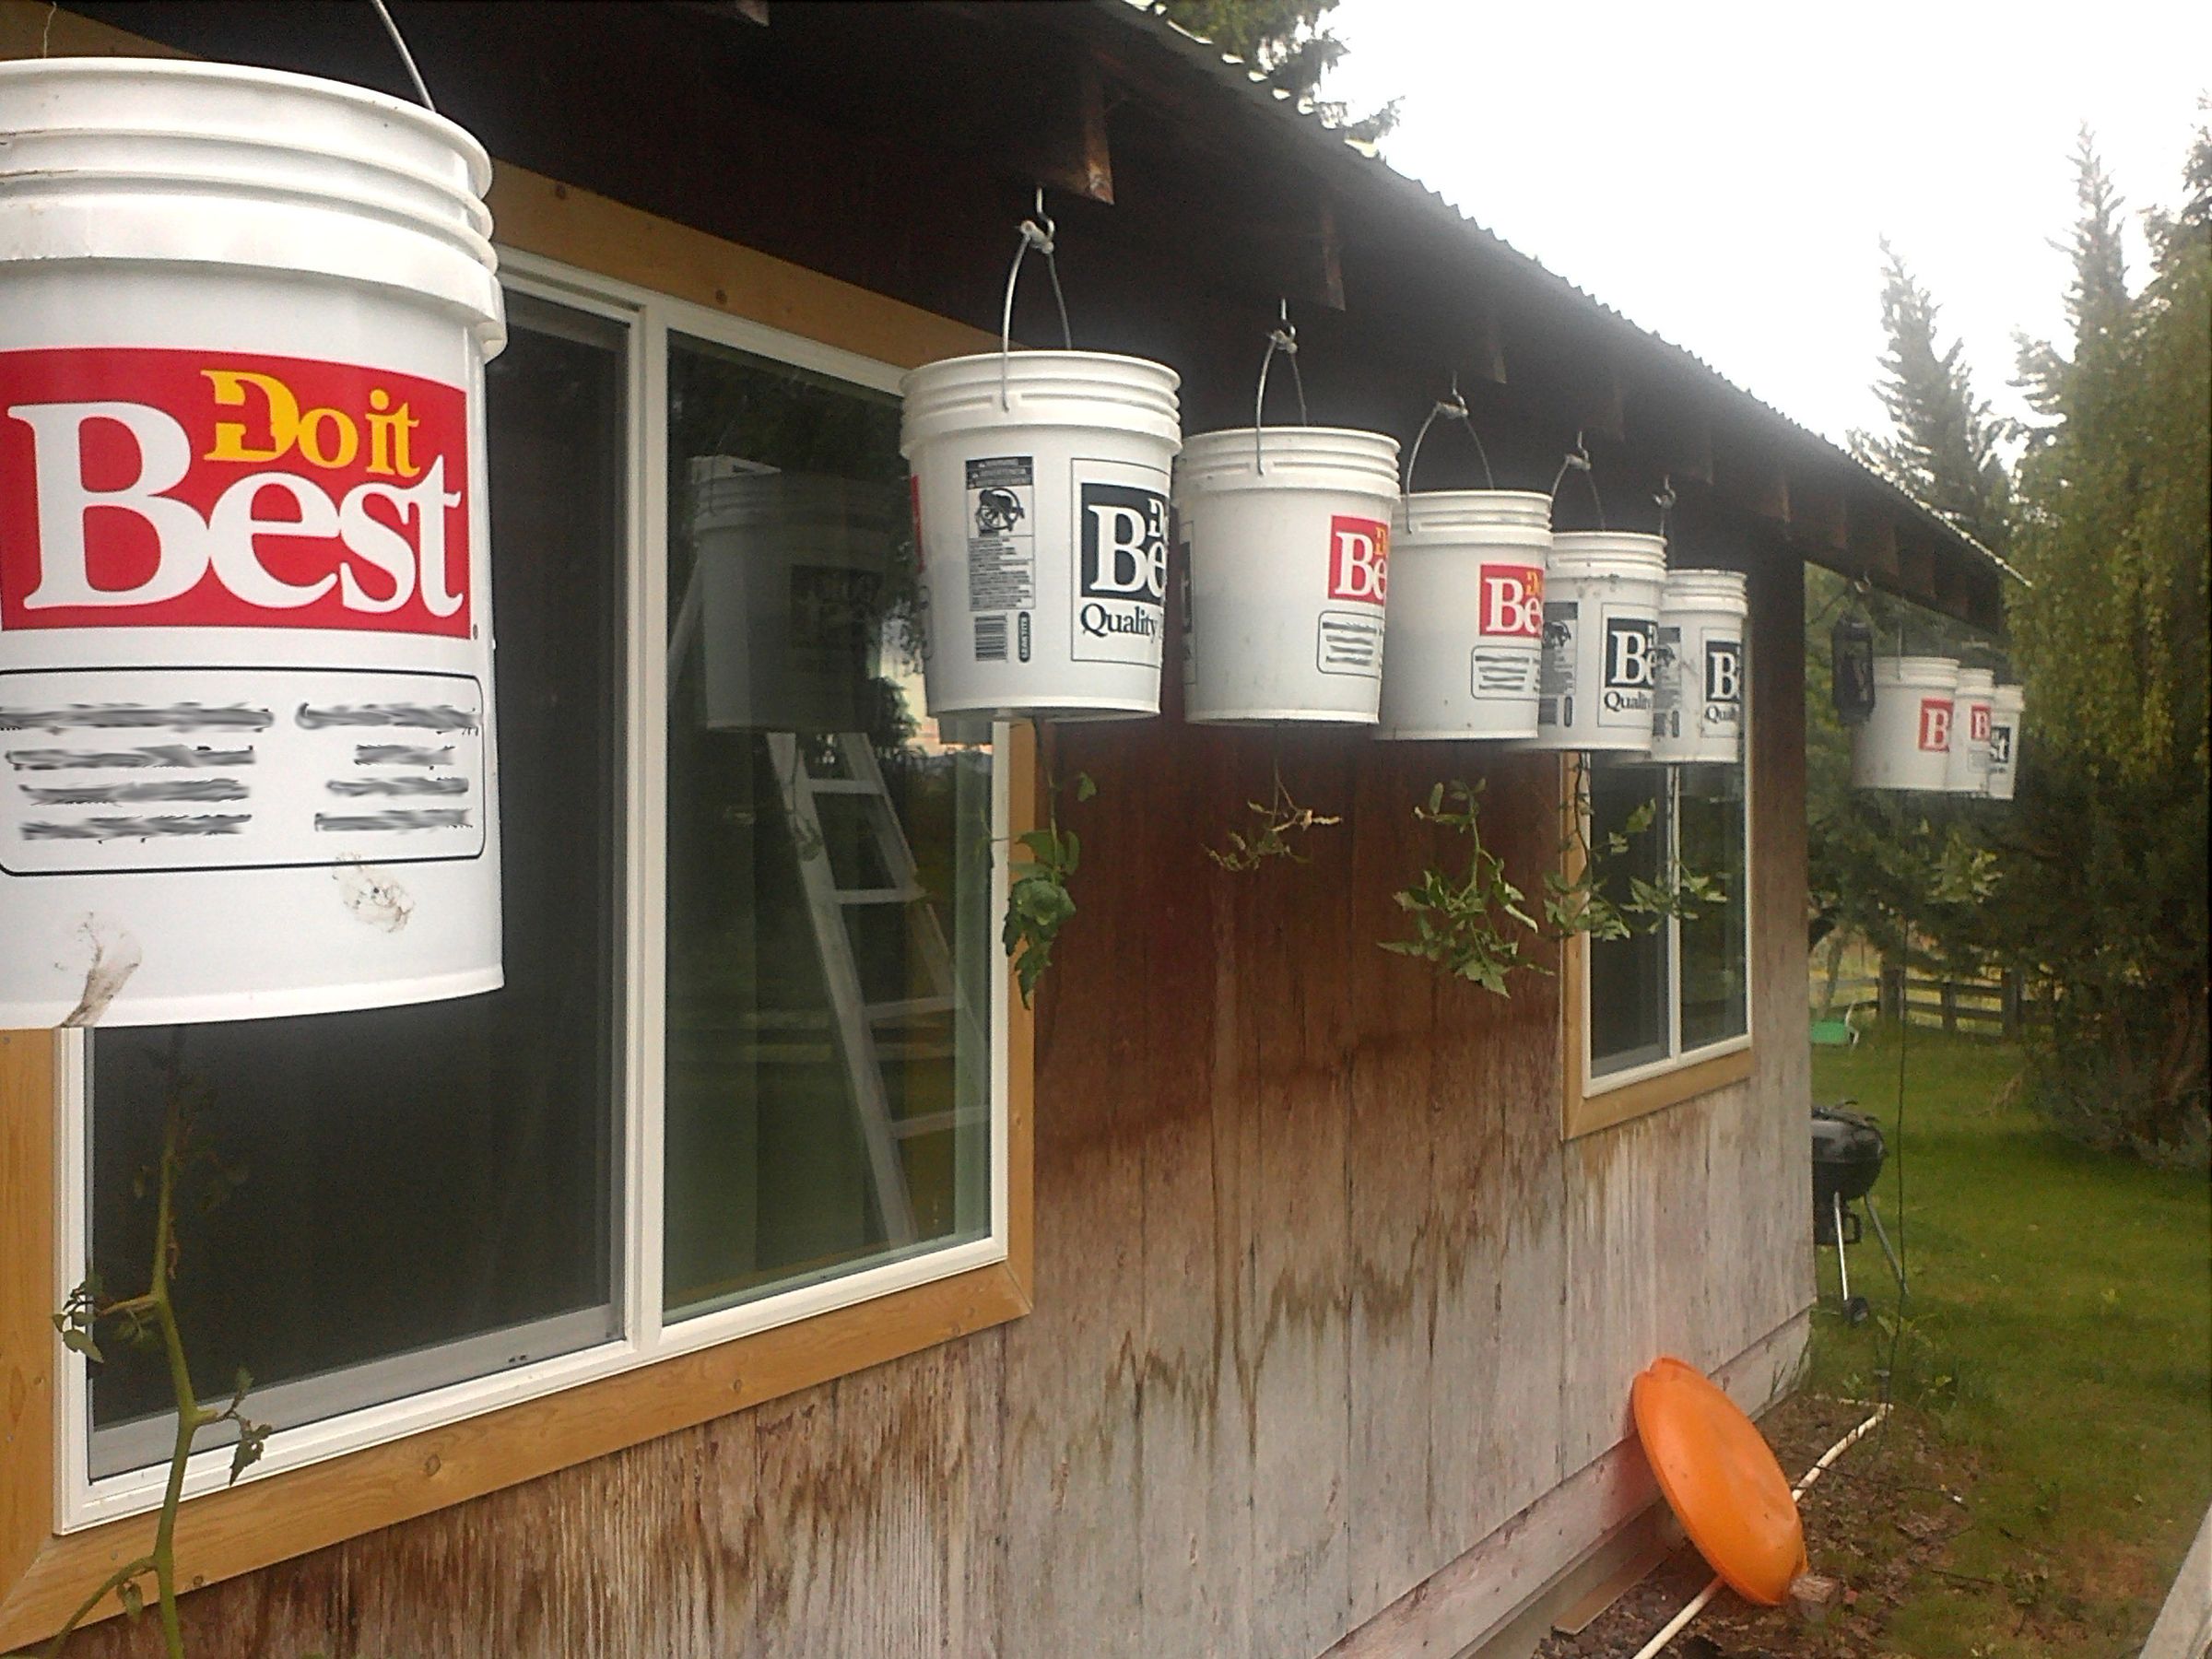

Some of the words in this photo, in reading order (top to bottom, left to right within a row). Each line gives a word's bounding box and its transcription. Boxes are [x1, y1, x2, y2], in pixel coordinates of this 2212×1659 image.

[200, 369, 360, 469] Do
[366, 388, 421, 478] it
[7, 401, 465, 618] Best
[1080, 603, 1159, 644] Quality
